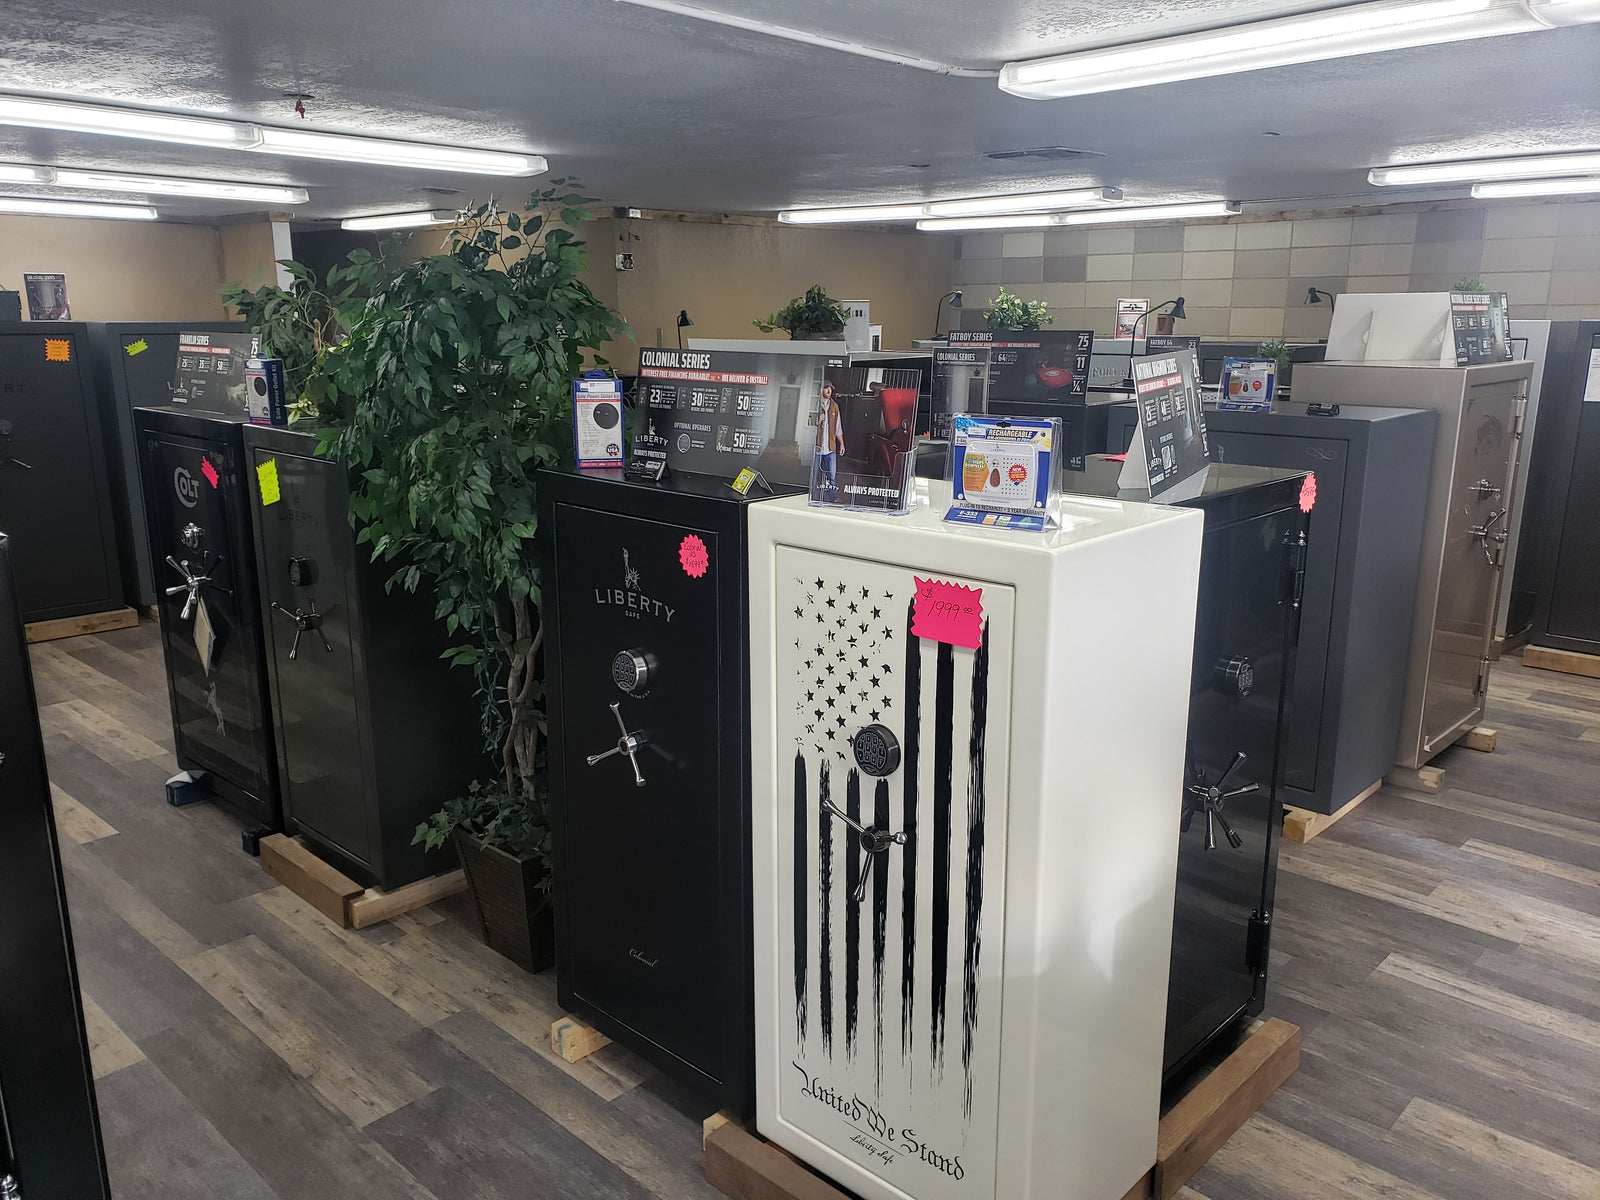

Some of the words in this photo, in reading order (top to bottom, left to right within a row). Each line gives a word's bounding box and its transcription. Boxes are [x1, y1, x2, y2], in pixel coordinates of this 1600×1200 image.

[950, 332, 972, 342] FATBOY
[972, 332, 993, 342] SERIES
[1078, 336, 1089, 348] 75
[642, 351, 679, 367] COLONIAL
[681, 353, 711, 369] SERIES
[937, 353, 958, 361] COLONIAL
[959, 353, 975, 361] SERIES
[998, 353, 1006, 362] 64
[1076, 356, 1085, 368] 11
[650, 389, 660, 403] 23
[691, 392, 703, 407] 30
[737, 395, 749, 410] 50
[988, 428, 1033, 438] RECHARGEABLE
[635, 435, 668, 447] LIBERTY
[733, 433, 745, 448] 50
[648, 450, 667, 459] PROTECTED
[174, 466, 199, 508] COLT
[844, 485, 867, 495] ALWAYS
[868, 487, 899, 498] PROTECTED
[921, 587, 934, 600] $
[595, 588, 675, 623] LIBERTY
[625, 611, 640, 619] SAFE
[792, 1060, 868, 1121] United
[867, 1105, 895, 1142] We
[900, 1128, 965, 1181] Stand
[850, 1134, 877, 1156] Liberty
[877, 1150, 894, 1165] Safe
